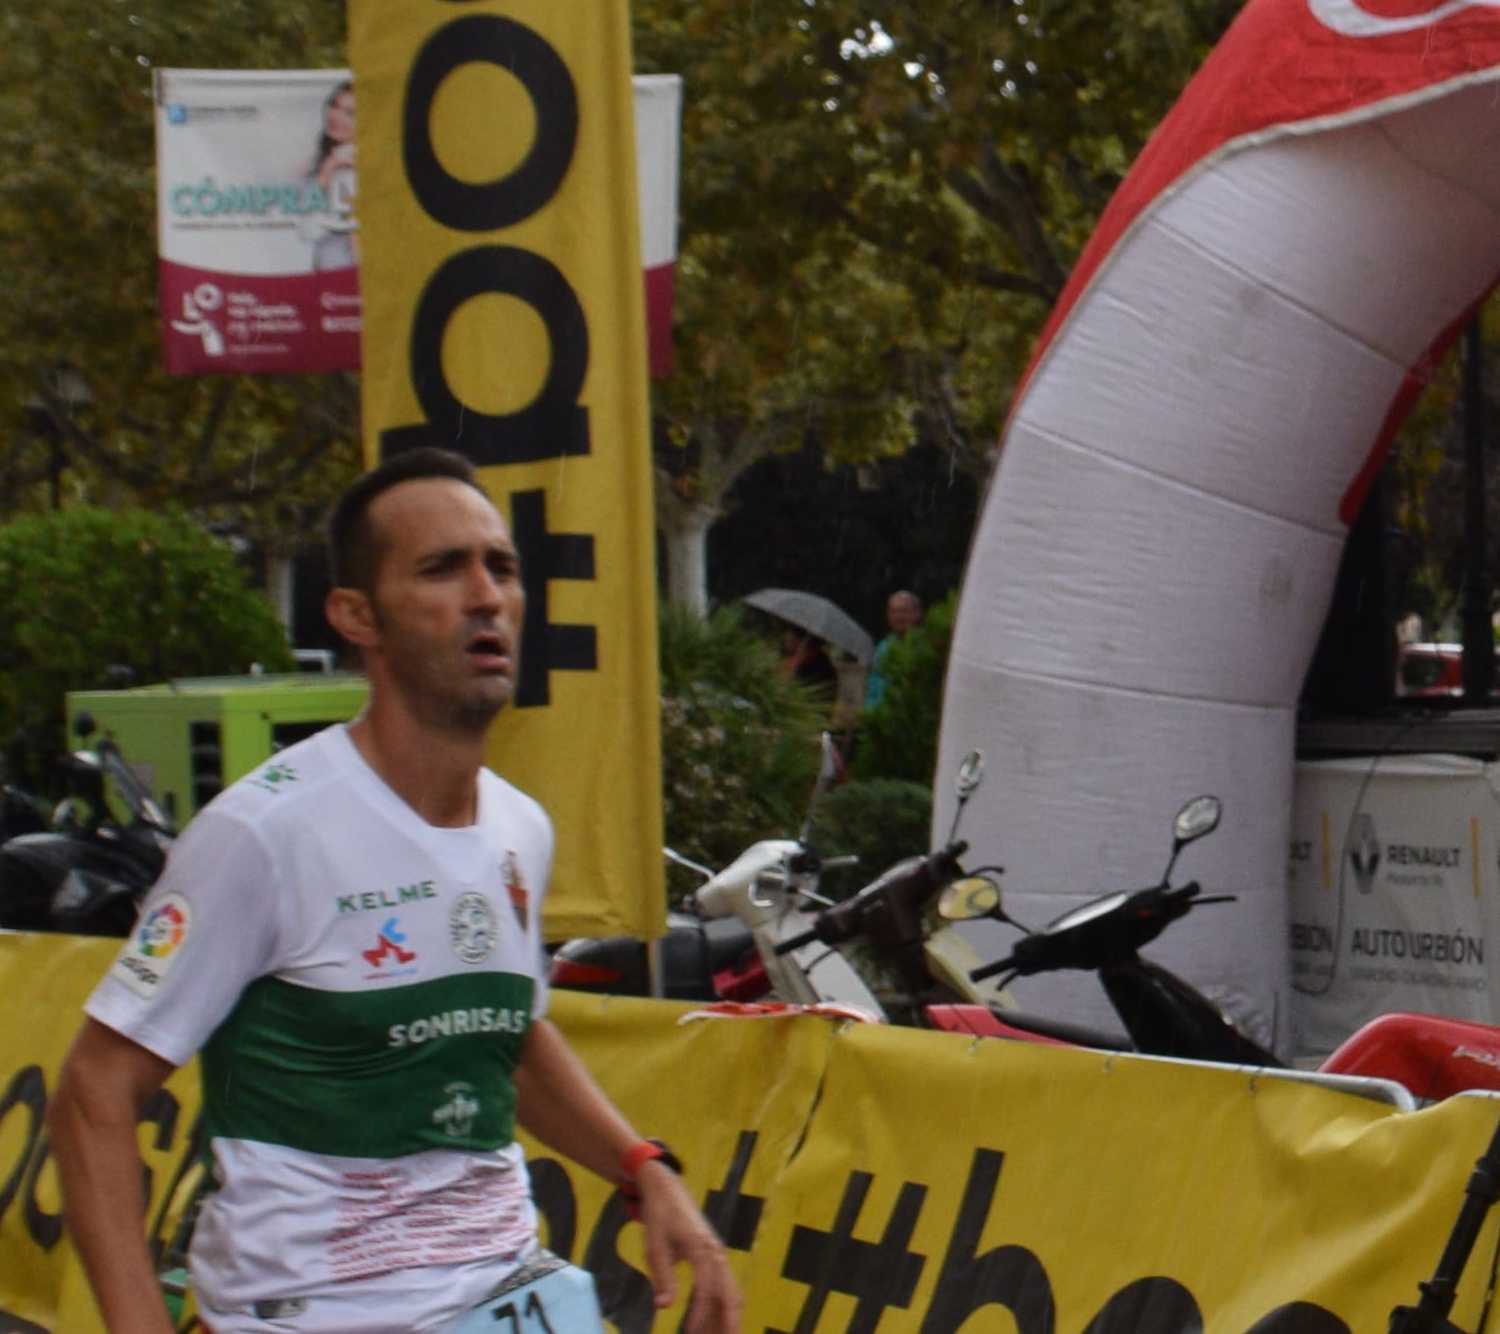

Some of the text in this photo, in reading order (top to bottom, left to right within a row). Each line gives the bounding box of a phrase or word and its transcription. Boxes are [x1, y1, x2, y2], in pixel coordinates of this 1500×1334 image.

[1388, 844, 1461, 869] RENAULT
[335, 879, 438, 914] KELME
[386, 1006, 528, 1049] SONRISAS
